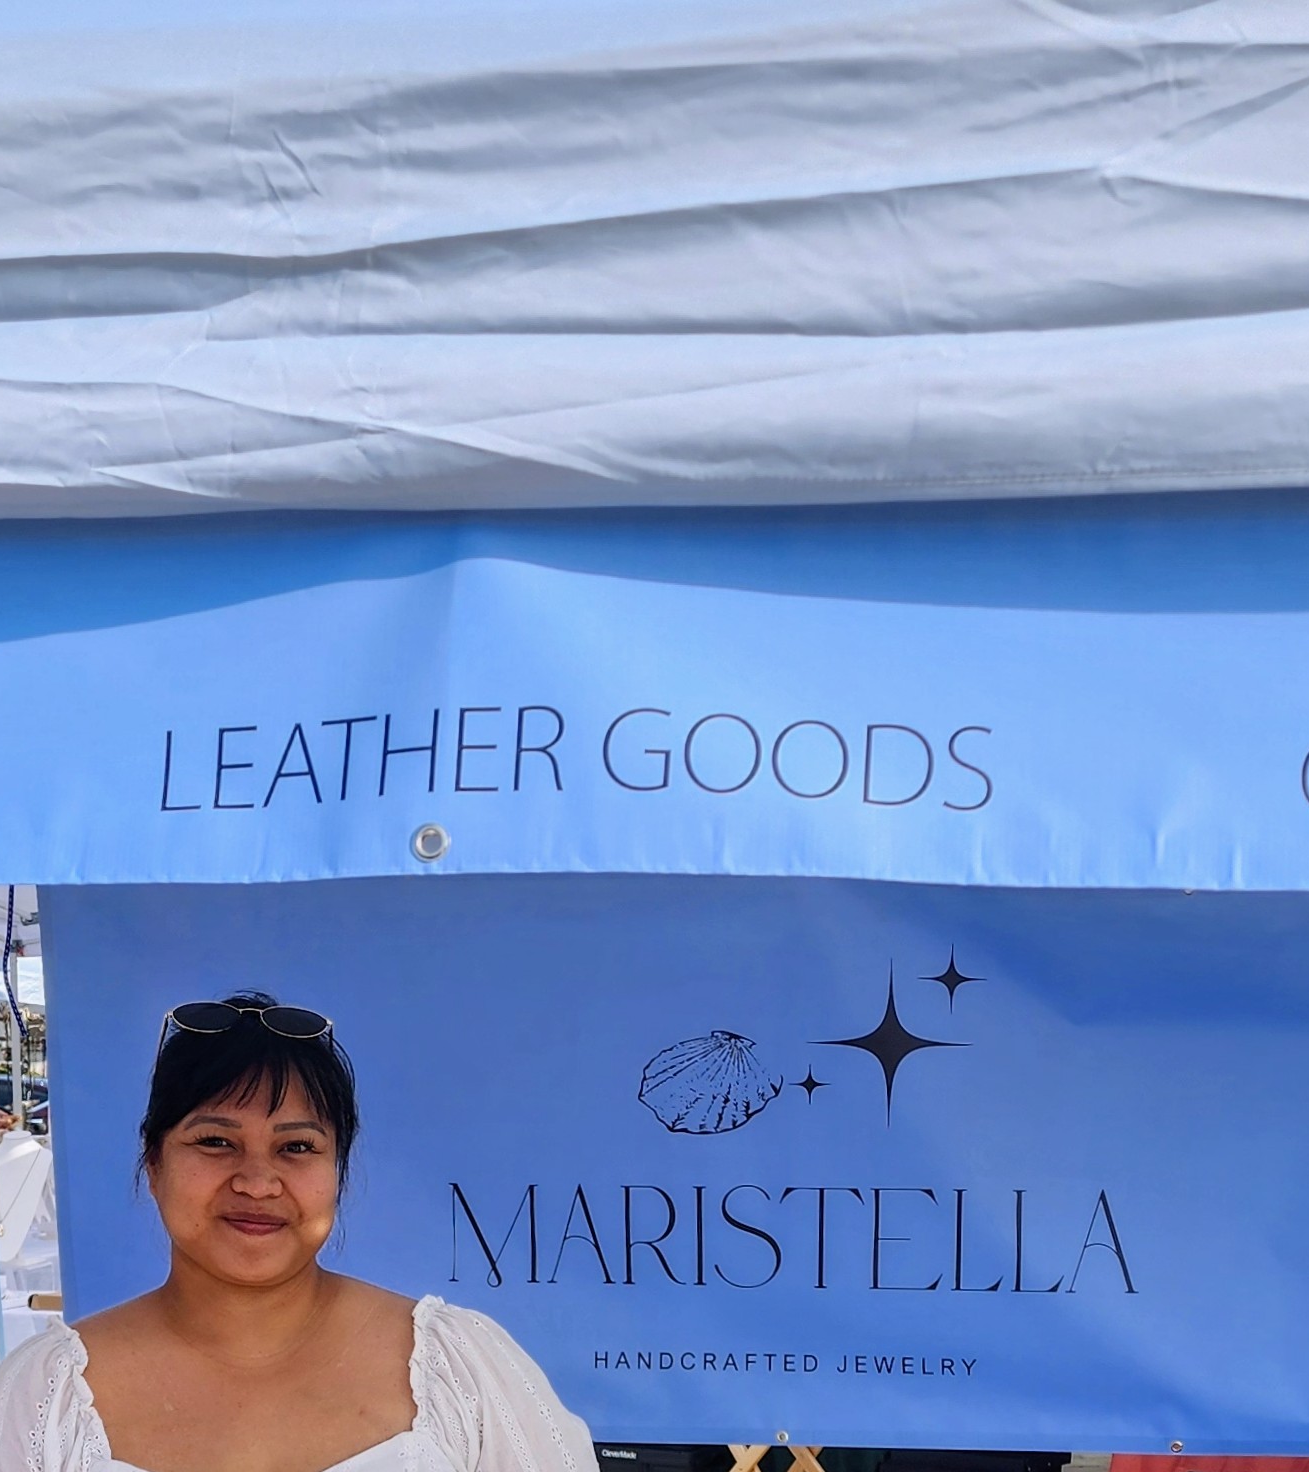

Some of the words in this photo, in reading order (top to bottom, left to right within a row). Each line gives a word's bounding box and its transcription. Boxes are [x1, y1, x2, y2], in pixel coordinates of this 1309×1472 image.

[160, 704, 565, 812] LEATHER
[602, 707, 993, 812] GOODS
[448, 1182, 1140, 1294] MARISTELLA
[594, 1350, 818, 1373] HANDCRAFTED
[836, 1354, 978, 1377] JEWELRY
